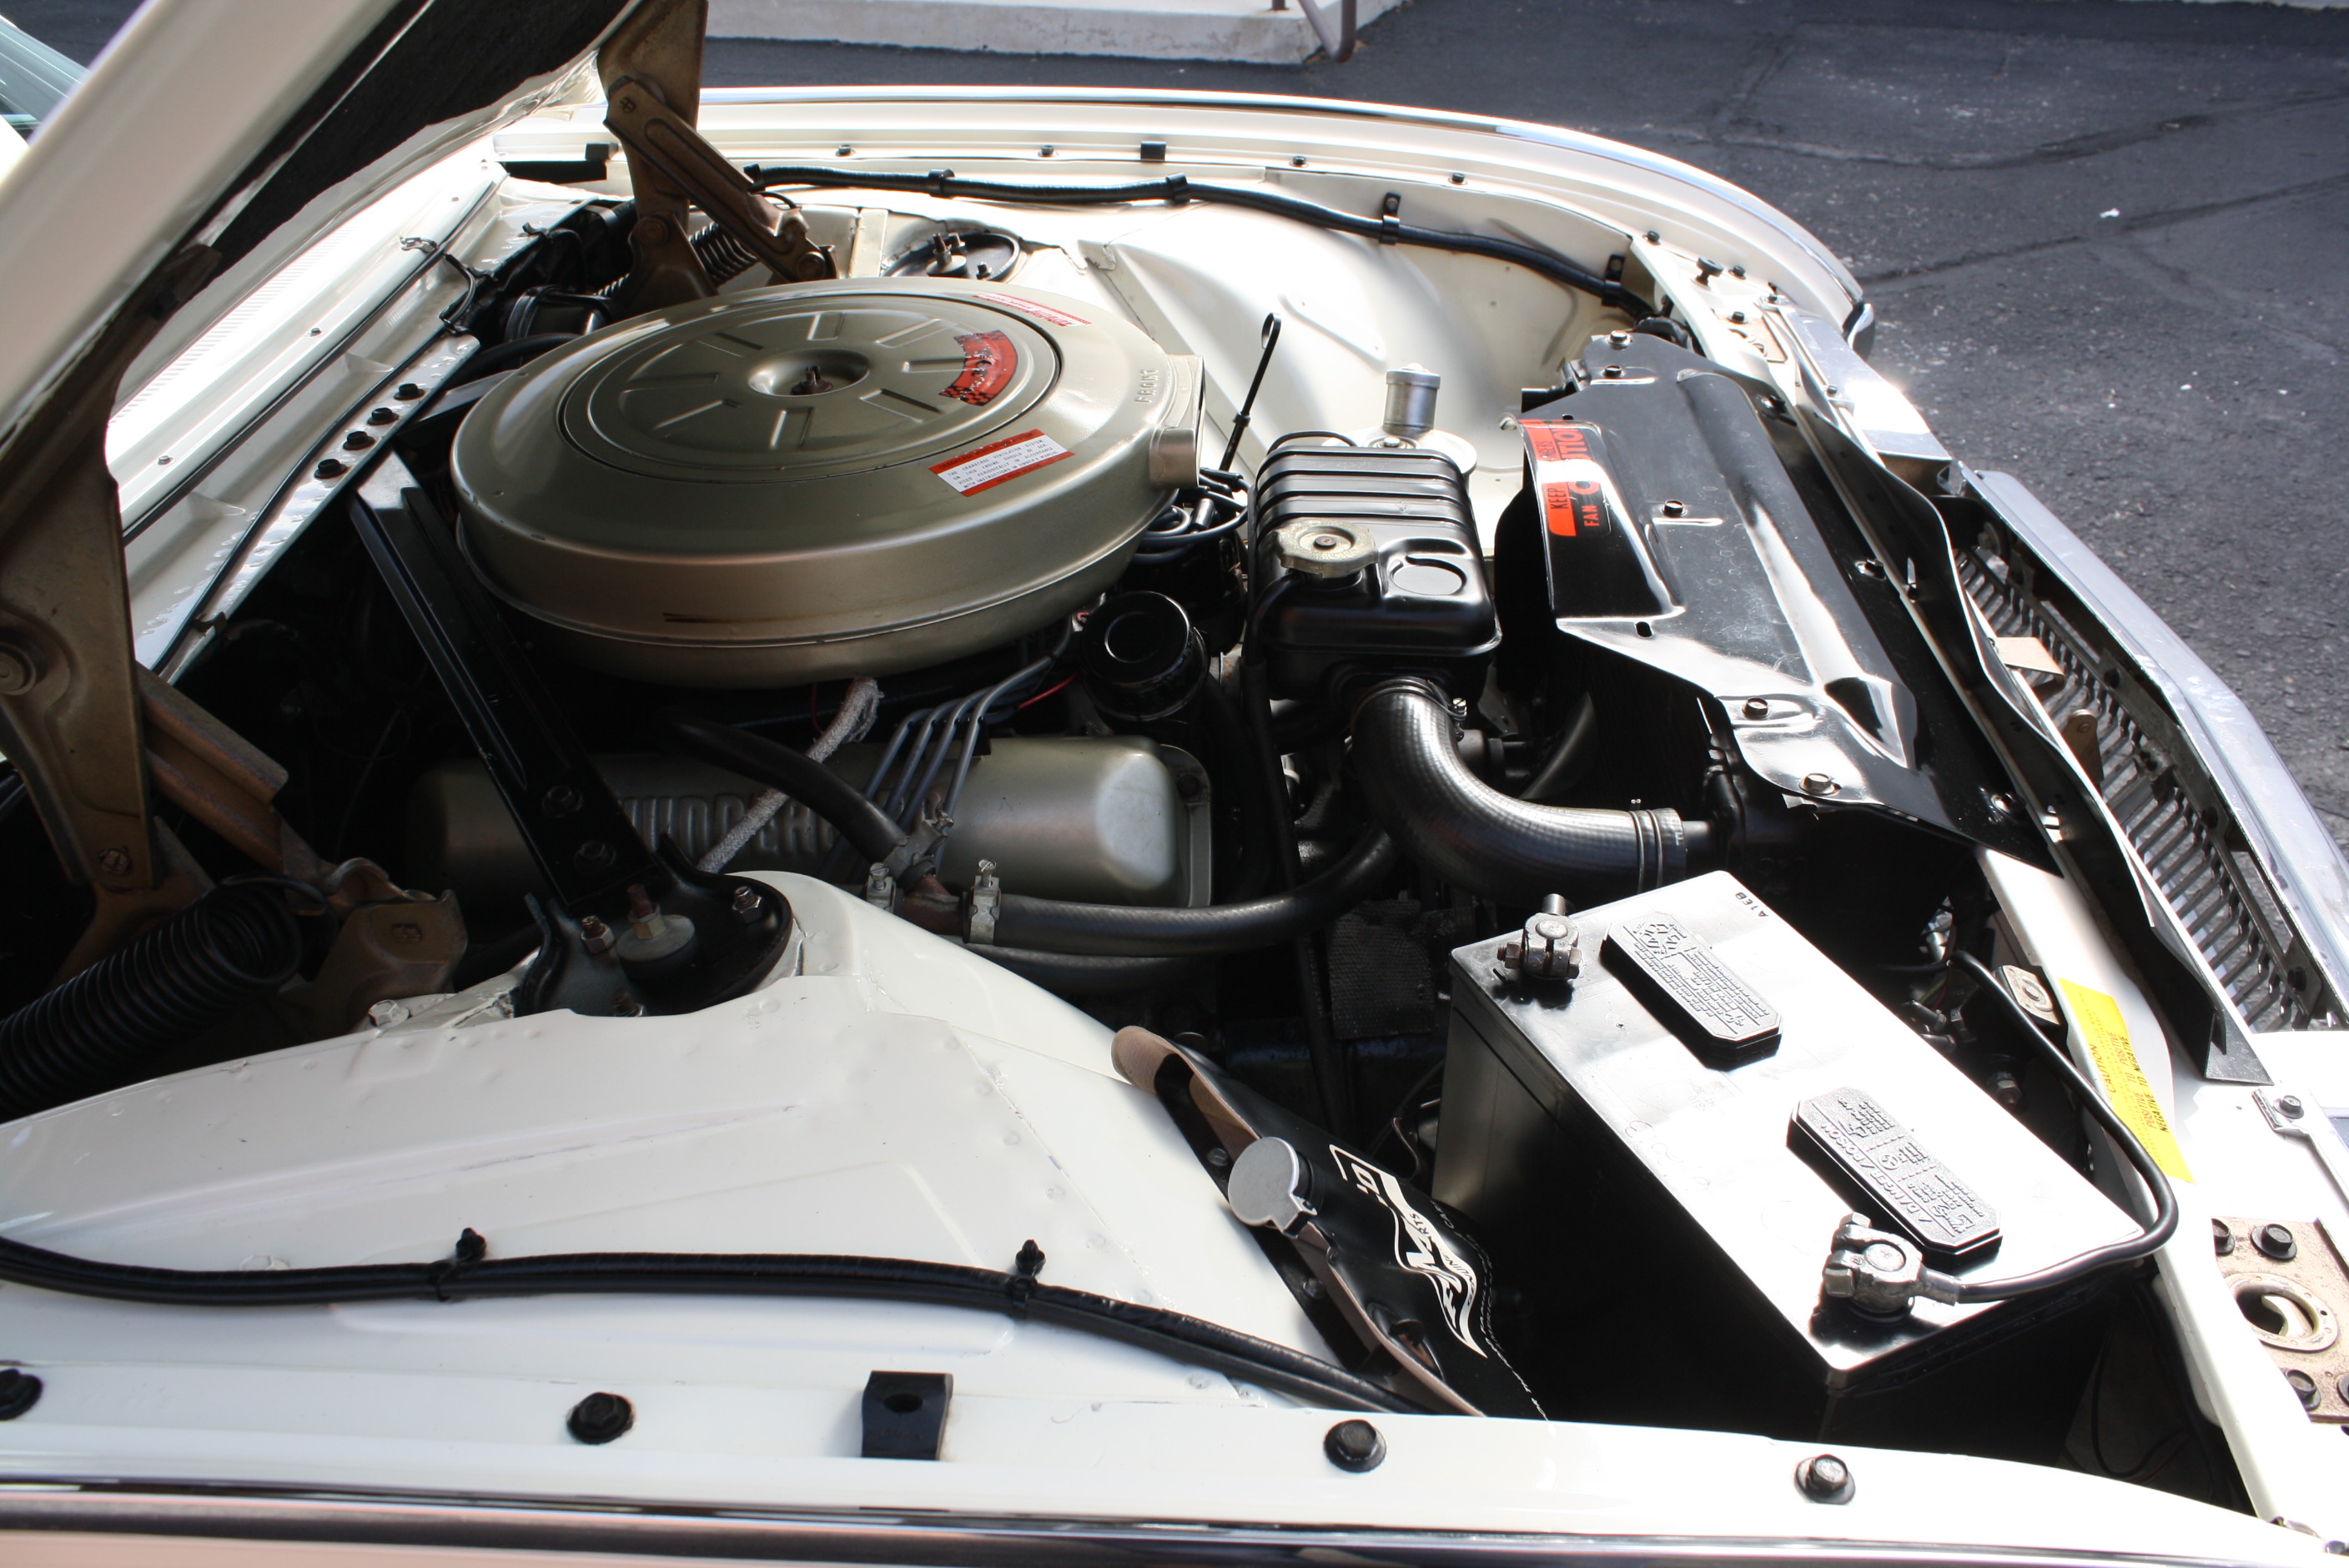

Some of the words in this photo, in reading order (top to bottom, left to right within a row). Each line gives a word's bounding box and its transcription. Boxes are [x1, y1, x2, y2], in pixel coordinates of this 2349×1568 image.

[1134, 367, 1159, 405] FRONT
[1547, 488, 1569, 510] KEEP
[1582, 505, 1600, 527] FAN
[2106, 1031, 2128, 1065] POSITIVE
[2118, 1035, 2141, 1073] NEGATIVE
[2089, 1043, 2115, 1093] CAUTION
[2124, 1072, 2136, 1083] TO
[2136, 1076, 2147, 1087] TO
[2132, 1091, 2155, 1128] POSITIVE
[2144, 1093, 2168, 1132] NEGATIVE
[1820, 1120, 1868, 1162] POISON
[1894, 1151, 1909, 1163] NO
[1869, 1169, 1922, 1214] DANGER
[1907, 1184, 1931, 1203] SHIELD
[1917, 1183, 1939, 1200] EYES
